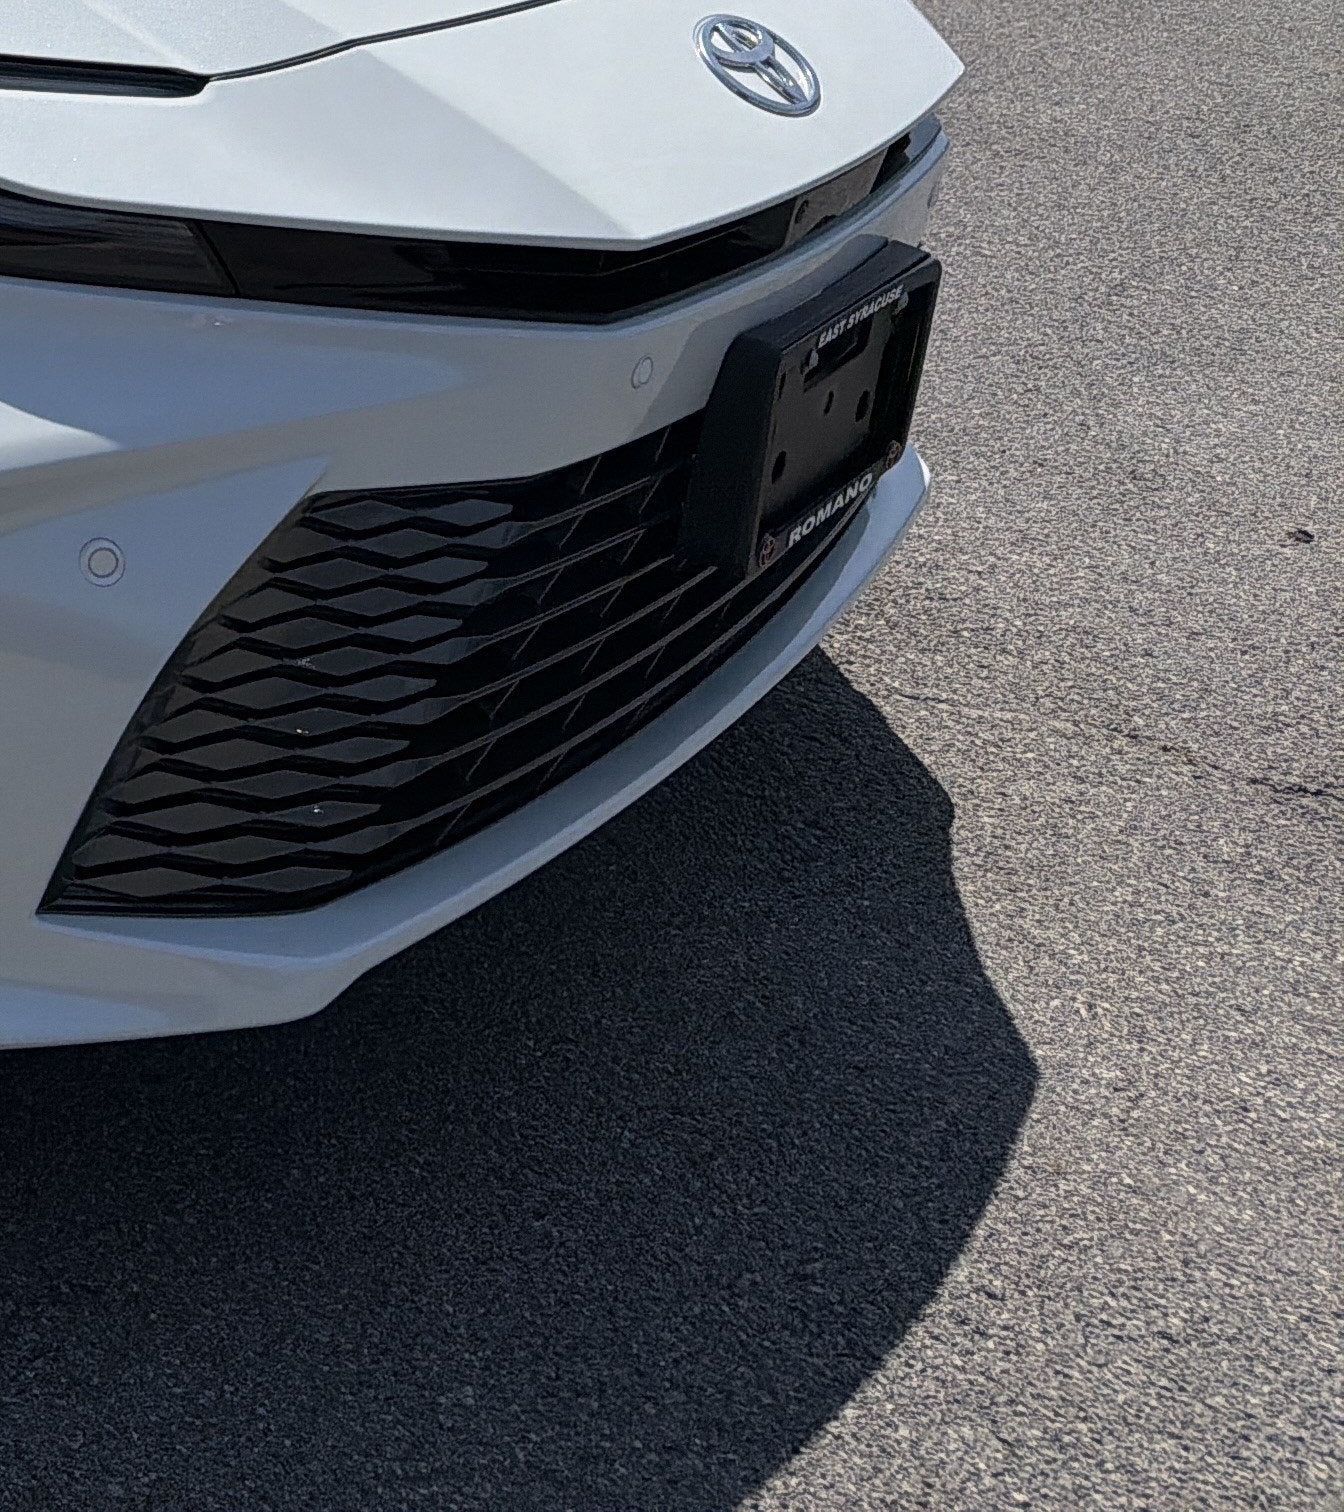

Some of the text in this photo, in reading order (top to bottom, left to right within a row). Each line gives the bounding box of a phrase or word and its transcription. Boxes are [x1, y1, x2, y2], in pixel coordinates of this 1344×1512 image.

[818, 284, 904, 348] EAST SYRACUSE
[786, 472, 873, 549] ROMANO
